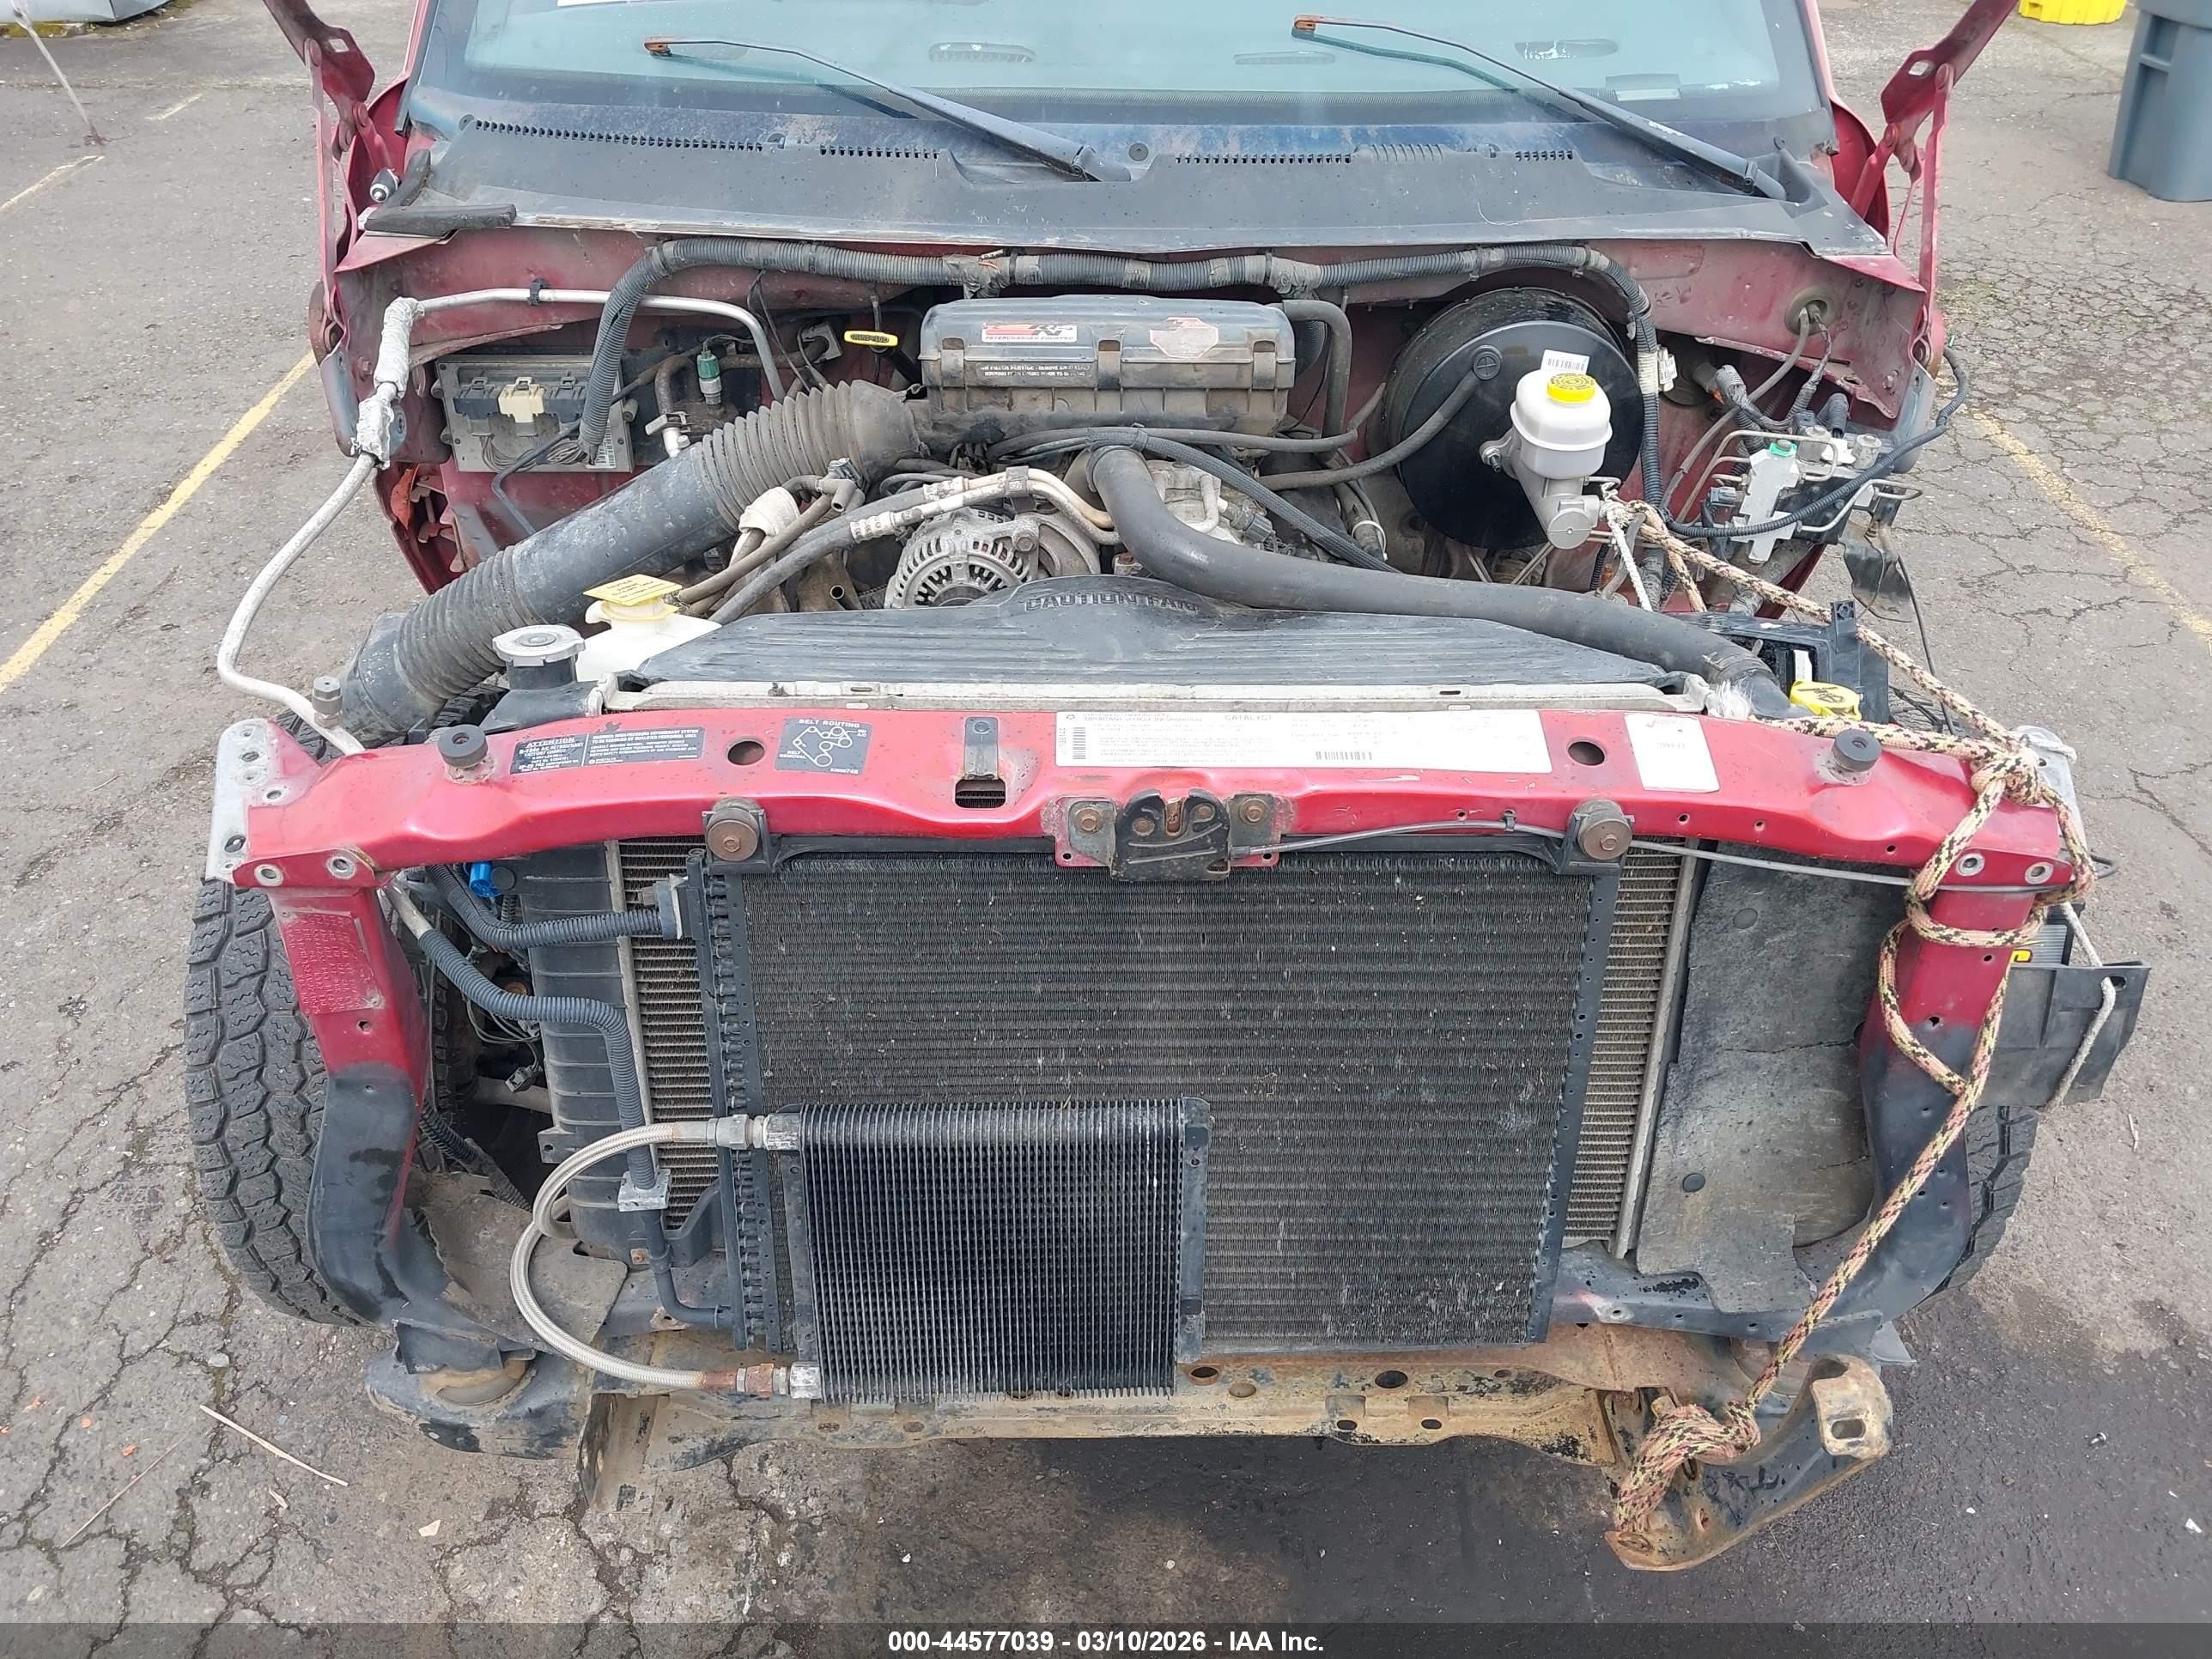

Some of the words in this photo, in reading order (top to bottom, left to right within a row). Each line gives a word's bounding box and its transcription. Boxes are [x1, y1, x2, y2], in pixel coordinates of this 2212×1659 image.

[1024, 590, 1137, 612] CAUTION
[1147, 595, 1197, 613] FAN
[822, 720, 860, 728] ROUTING
[526, 737, 576, 748] ATTENTION
